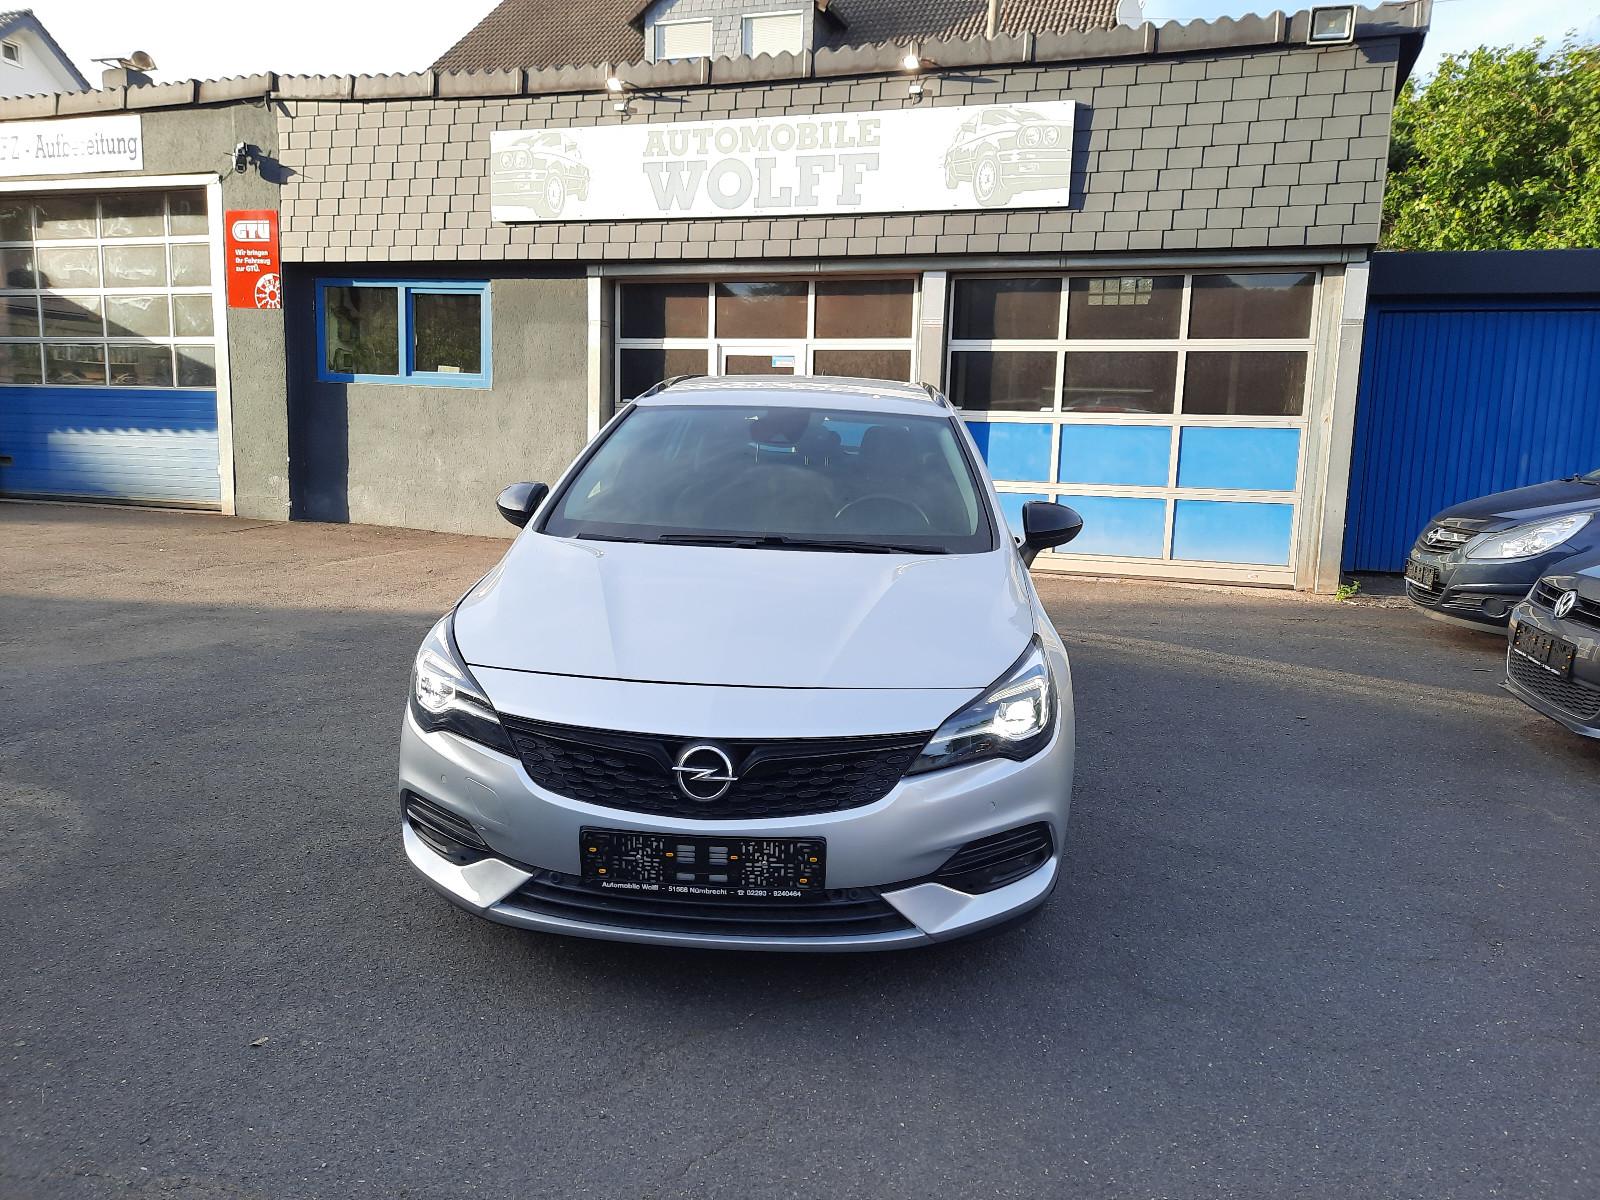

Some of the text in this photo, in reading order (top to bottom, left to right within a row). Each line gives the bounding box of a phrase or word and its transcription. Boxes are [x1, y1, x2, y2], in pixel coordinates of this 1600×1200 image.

[643, 119, 880, 156] AUTOMOBILE
[643, 153, 880, 210] WOLFF
[601, 881, 641, 890] Automobile
